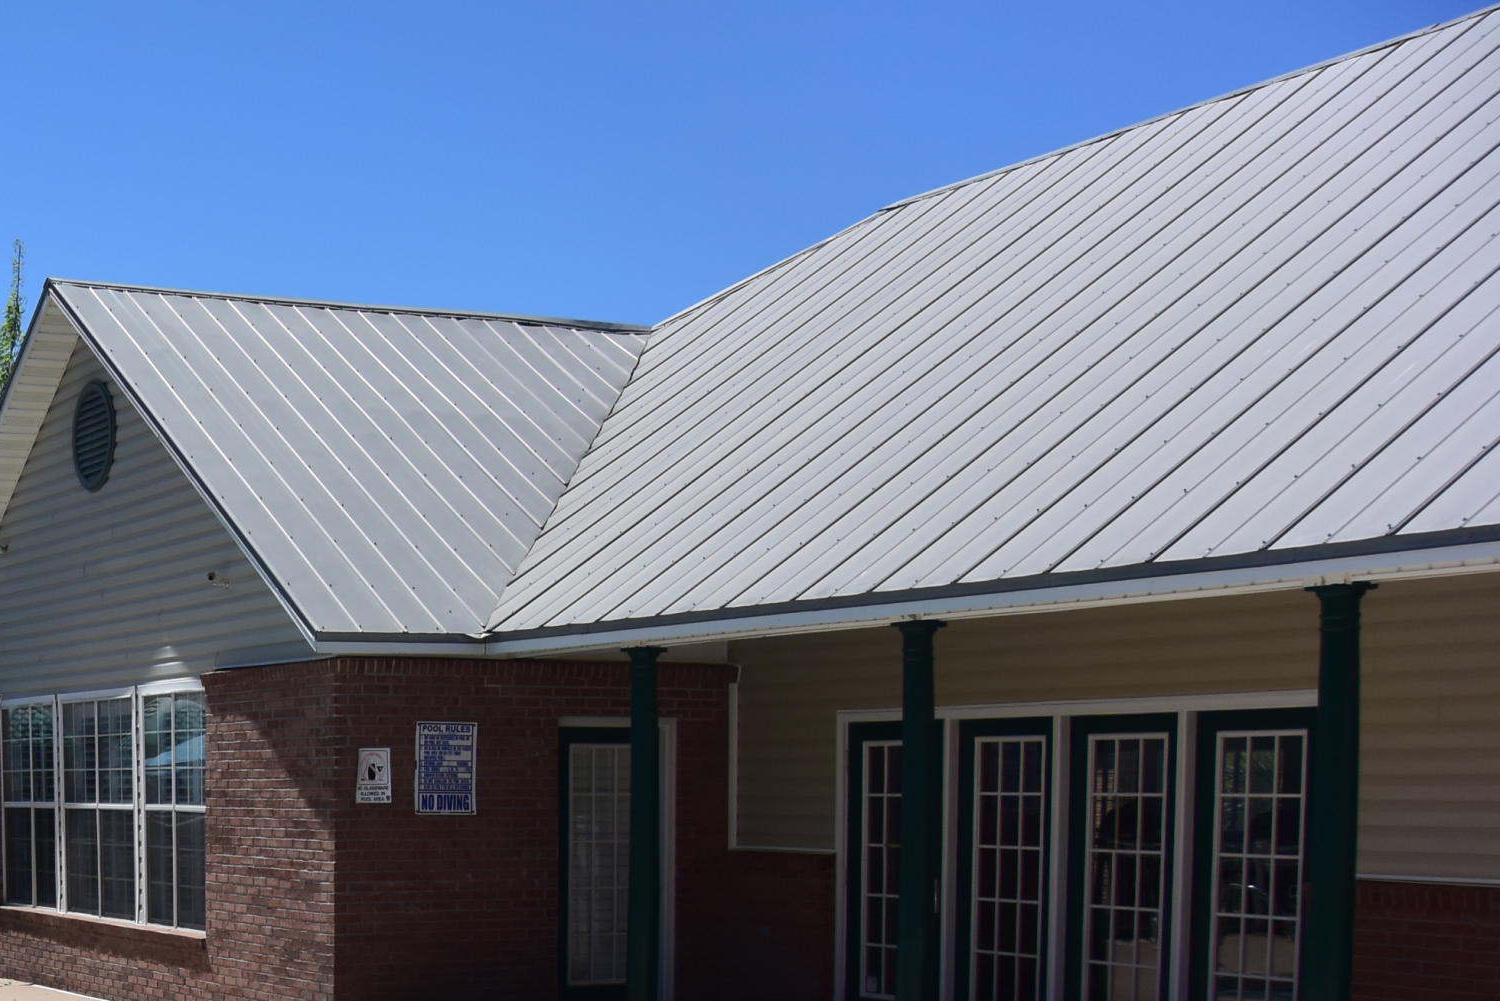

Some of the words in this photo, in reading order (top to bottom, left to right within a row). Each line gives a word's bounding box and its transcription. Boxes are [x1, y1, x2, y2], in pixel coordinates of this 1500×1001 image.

[445, 725, 470, 733] RULES
[421, 794, 434, 811] NO
[436, 794, 470, 811] DIVING
